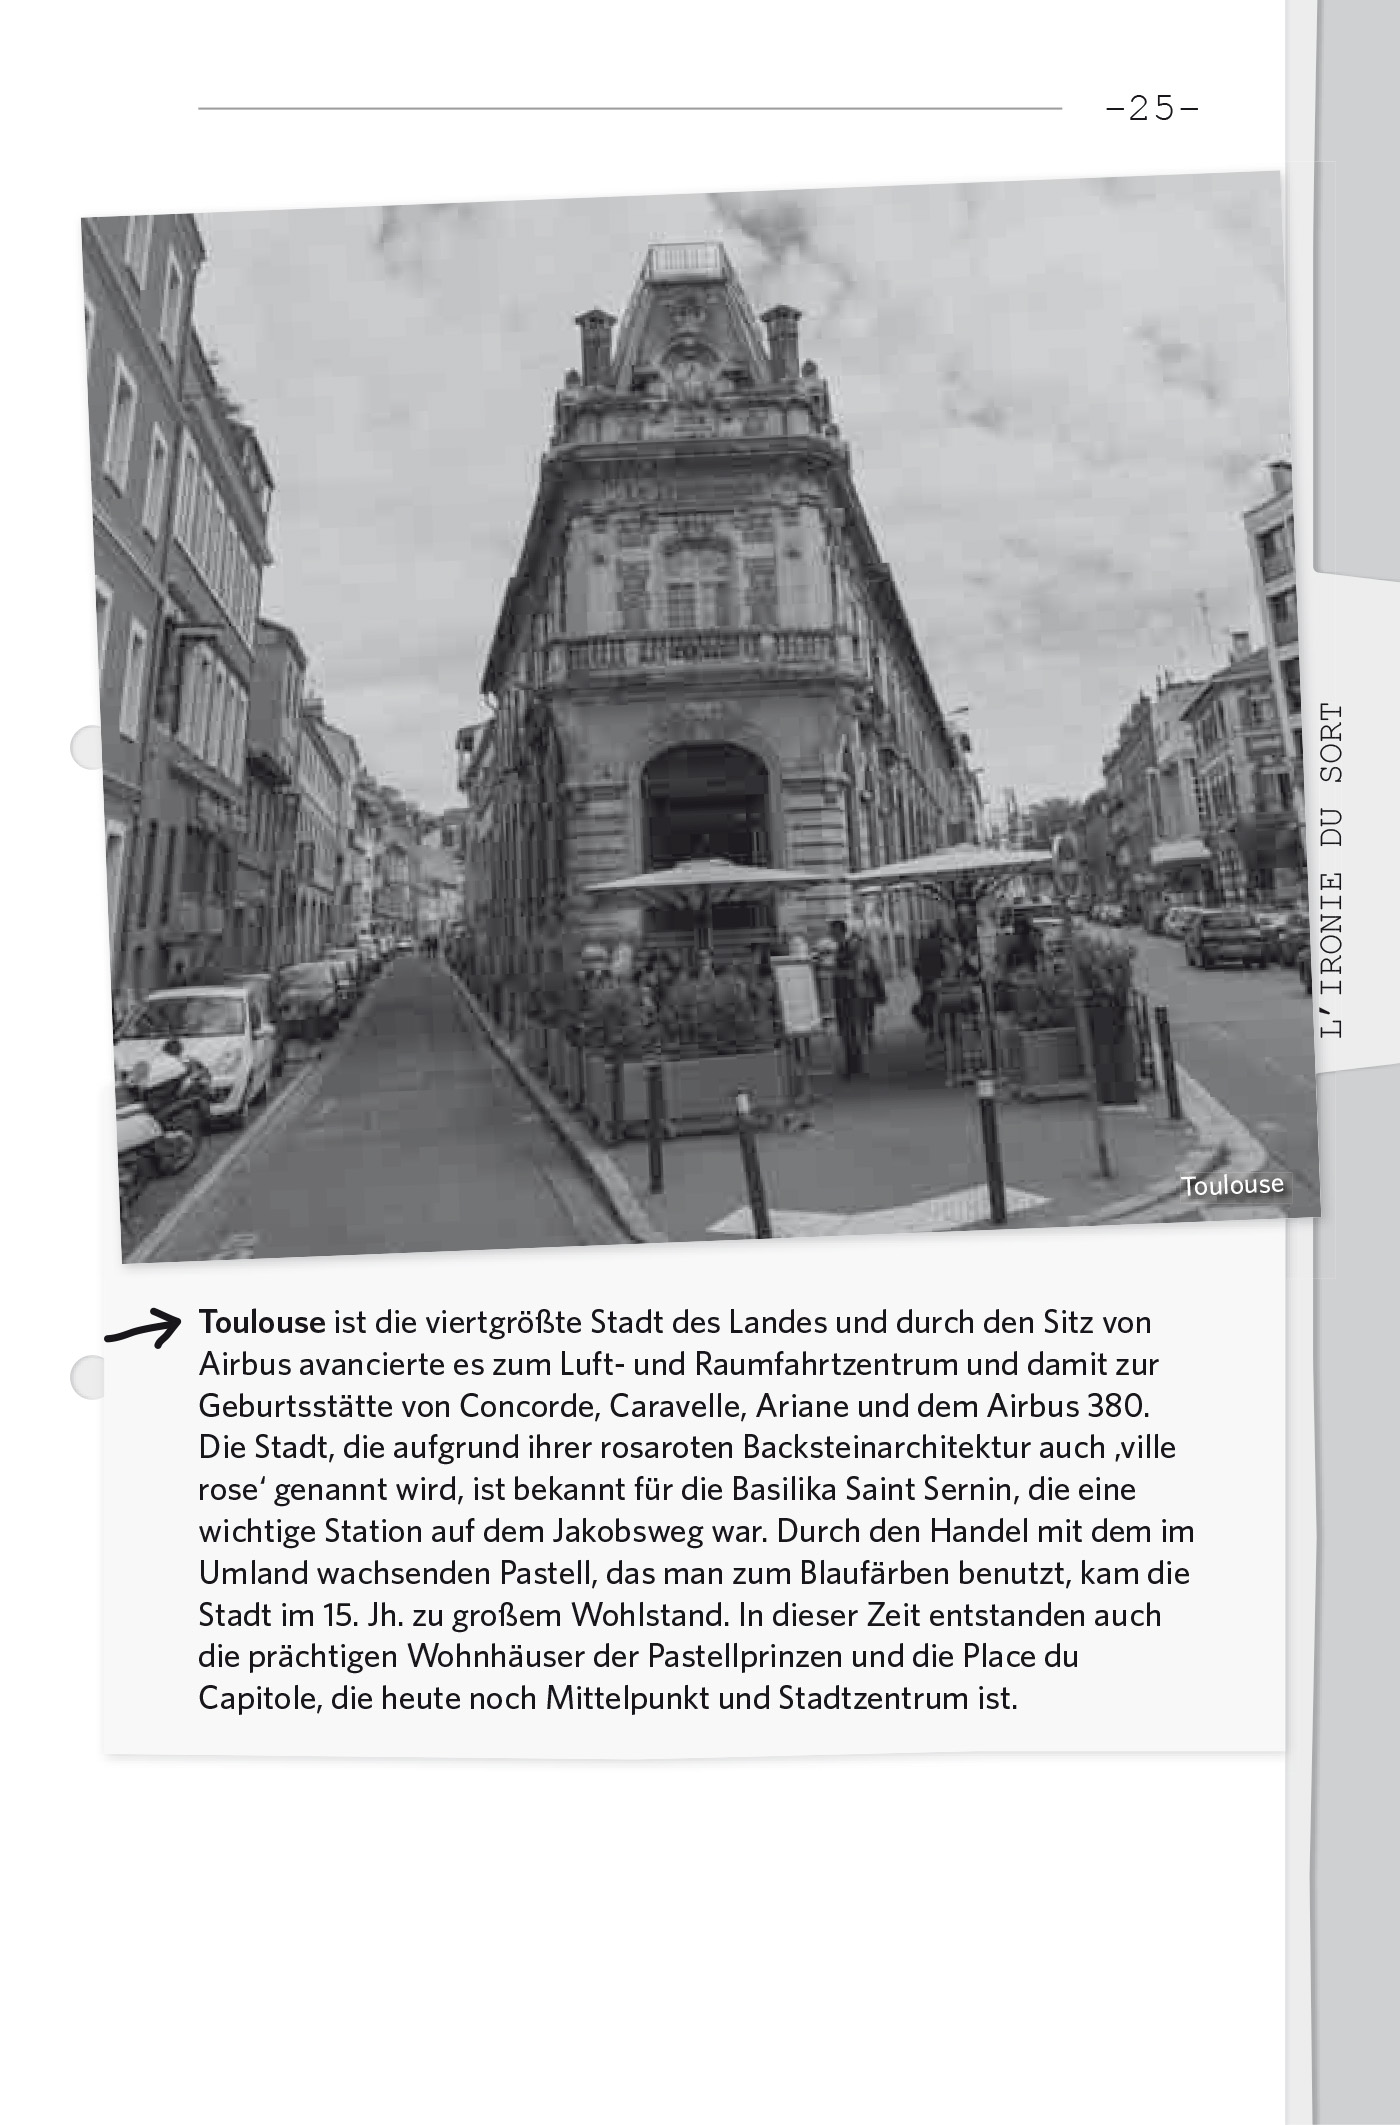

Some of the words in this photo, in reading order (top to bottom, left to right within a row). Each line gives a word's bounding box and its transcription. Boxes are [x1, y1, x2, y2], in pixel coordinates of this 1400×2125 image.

[1106, 94, 1199, 121] -25-
[1319, 702, 1343, 783] SORT
[1320, 807, 1343, 847] DU
[198, 1308, 326, 1334] Toulouse
[334, 1309, 367, 1334] ist
[375, 1308, 417, 1334] die
[425, 1308, 582, 1340] viertgrößte
[591, 1308, 664, 1334] Stadt
[672, 1308, 721, 1334] des
[730, 1308, 828, 1334] Landes
[836, 1308, 887, 1334] und
[896, 1308, 974, 1334] durch
[983, 1308, 1034, 1334] den
[1044, 1308, 1094, 1334] Sitz
[1102, 1316, 1151, 1334] von
[198, 1350, 292, 1376] Airbus
[299, 1351, 445, 1376] avancierte
[453, 1358, 485, 1376] es
[492, 1358, 551, 1376] zum
[561, 1350, 625, 1376] Luft-
[634, 1350, 685, 1376] und
[696, 1350, 958, 1376] Raumfahrtzentrum
[967, 1350, 1018, 1376] und
[1027, 1350, 1108, 1376] damit
[1115, 1358, 1160, 1376] zur
[199, 1392, 393, 1418] Geburtsstätte
[401, 1400, 450, 1418] von
[460, 1392, 601, 1422] Concorde,
[610, 1392, 747, 1422] Caravelle,
[755, 1392, 849, 1418] Ariane
[858, 1392, 909, 1418] und
[917, 1392, 978, 1418] dem
[986, 1392, 1080, 1418] Airbus
[1087, 1392, 1149, 1418] 380.
[200, 1433, 246, 1459] Die
[255, 1433, 335, 1463] Stadt,
[343, 1433, 385, 1459] die
[393, 1433, 519, 1465] aufgrund
[528, 1433, 593, 1459] ihrer
[601, 1435, 733, 1459] rosaroten
[744, 1433, 1032, 1459] Backsteinarchitektur
[1039, 1433, 1105, 1459] auch
[273, 1477, 388, 1507] genannt
[395, 1475, 464, 1505] wird,
[473, 1476, 506, 1501] ist
[514, 1475, 626, 1501] bekannt
[634, 1475, 674, 1501] für
[681, 1475, 723, 1501] die
[733, 1475, 836, 1501] Basilika
[846, 1475, 916, 1501] Saint
[924, 1475, 1020, 1505] Sernin,
[1028, 1475, 1070, 1501] die
[1078, 1476, 1136, 1501] eine
[198, 1517, 316, 1549] wichtige
[325, 1517, 422, 1543] Station
[431, 1517, 475, 1543] auf
[483, 1517, 544, 1543] dem
[552, 1517, 704, 1549] Jakobsweg
[711, 1525, 767, 1543] war.
[778, 1517, 860, 1543] Durch
[869, 1517, 920, 1543] den
[931, 1517, 1028, 1543] Handel
[1038, 1518, 1083, 1543] mit
[1091, 1517, 1151, 1543] dem
[1161, 1518, 1194, 1543] im
[200, 1559, 308, 1585] Umland
[316, 1559, 490, 1585] wachsenden
[501, 1559, 598, 1589] Pastell,
[606, 1559, 656, 1585] das
[664, 1567, 723, 1585] man
[732, 1567, 791, 1585] zum
[801, 1559, 949, 1585] Blaufärben
[959, 1559, 1072, 1589] benutzt,
[1081, 1559, 1139, 1585] kam
[1147, 1559, 1190, 1585] die
[199, 1601, 272, 1627] Stadt
[281, 1602, 314, 1627] im
[323, 1602, 358, 1627] 15.
[367, 1601, 403, 1627] Jh.
[412, 1609, 443, 1627] zu
[451, 1601, 561, 1633] großem
[571, 1601, 729, 1627] Wohlstand.
[740, 1601, 763, 1627] In
[772, 1601, 859, 1627] dieser
[867, 1601, 921, 1627] Zeit
[929, 1601, 1085, 1627] entstanden
[1094, 1601, 1161, 1627] auch
[198, 1642, 240, 1668] die
[249, 1642, 397, 1674] prächtigen
[407, 1642, 586, 1668] Wohnhäuser
[593, 1642, 640, 1668] der
[649, 1642, 842, 1674] Pastellprinzen
[852, 1642, 904, 1668] und
[912, 1642, 954, 1668] die
[964, 1642, 1036, 1668] Place
[1044, 1642, 1078, 1668] du
[199, 1684, 323, 1716] Capitole,
[331, 1684, 373, 1710] die
[382, 1684, 461, 1710] heute
[470, 1684, 536, 1710] noch
[546, 1684, 710, 1716] Mittelpunkt
[719, 1684, 770, 1710] und
[779, 1684, 968, 1710] Stadtzentrum
[978, 1685, 1017, 1710] ist.
